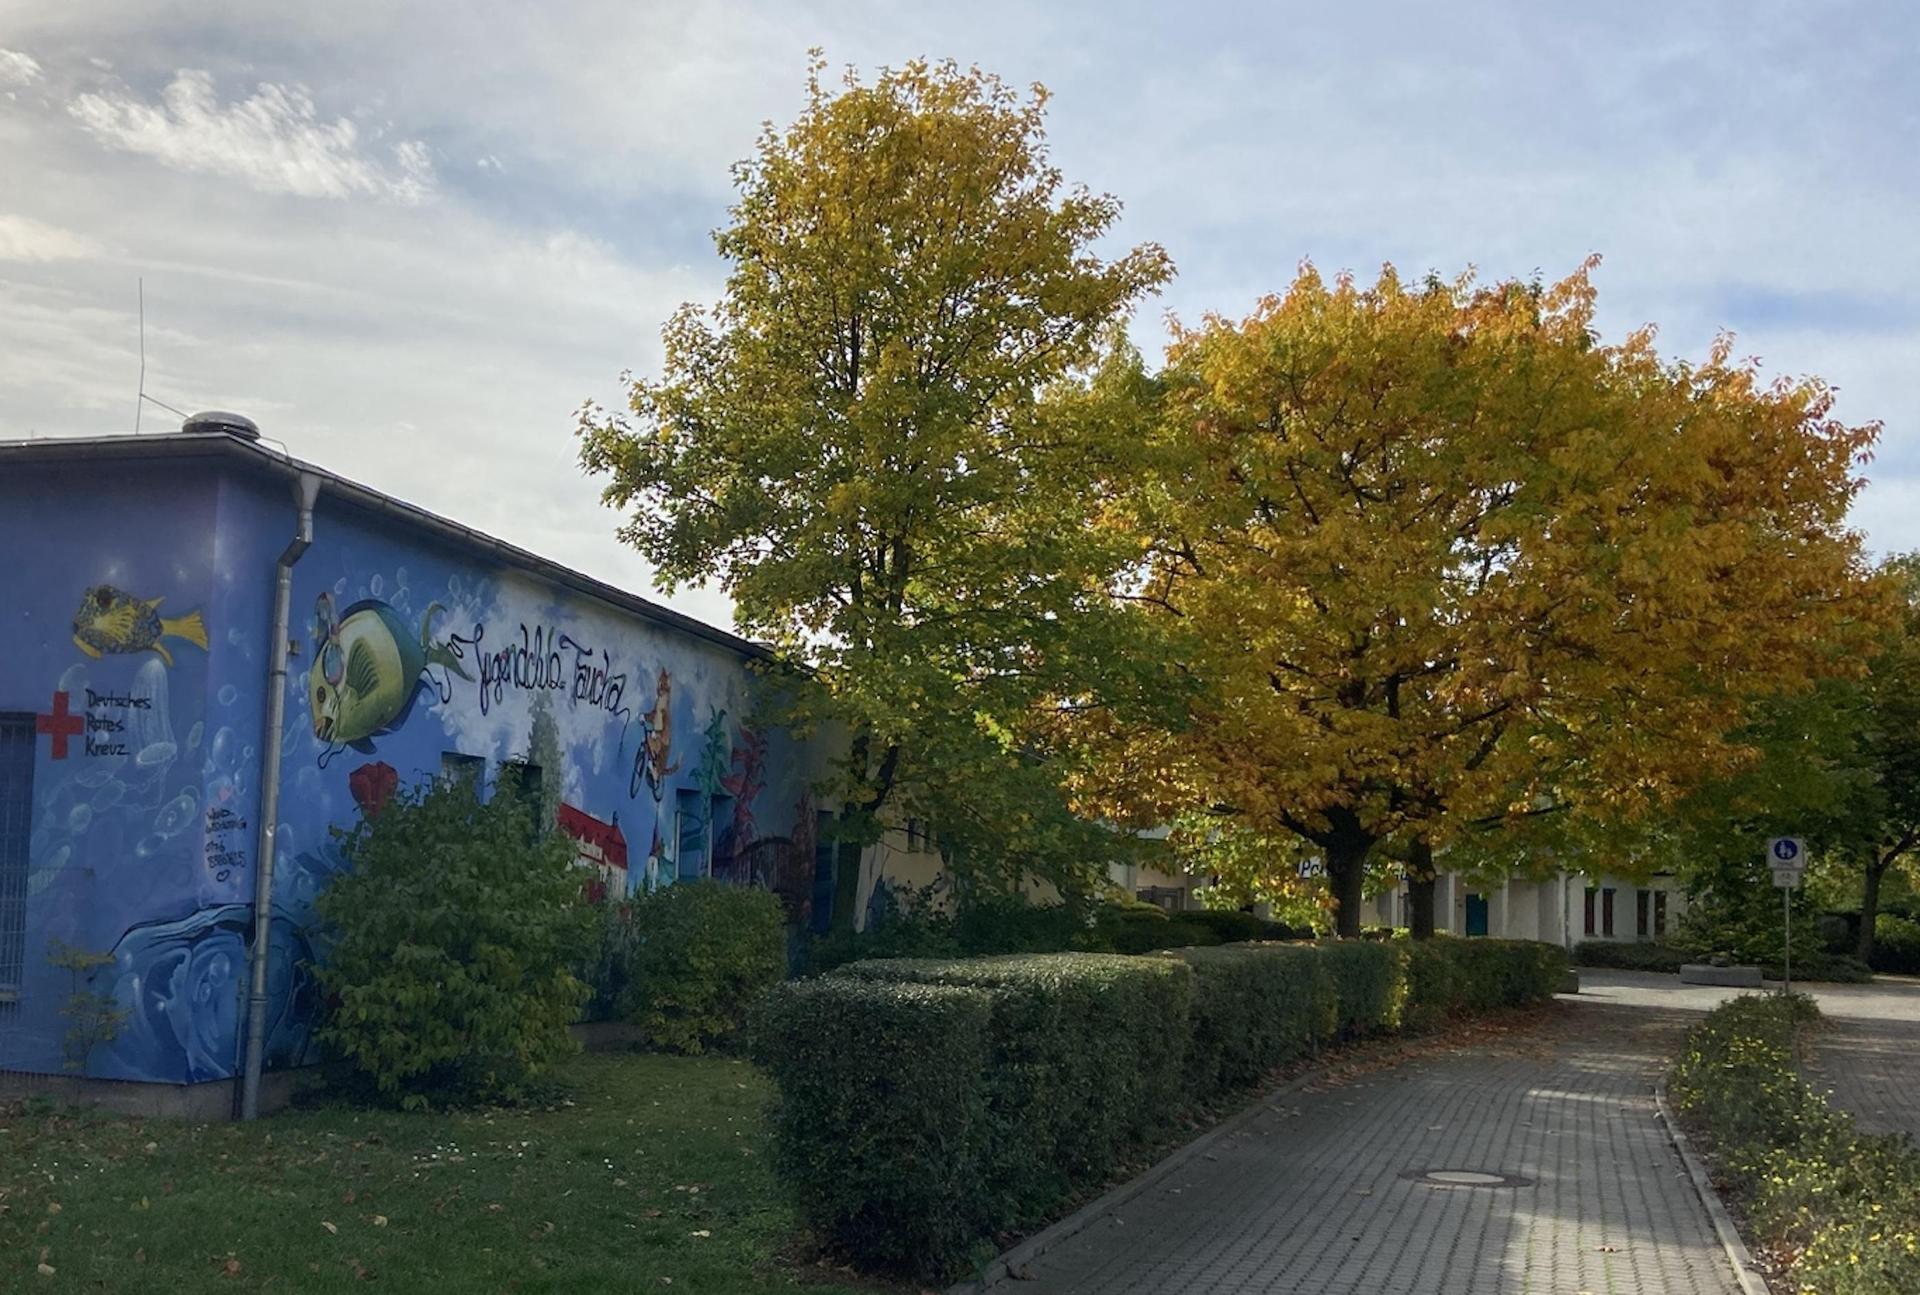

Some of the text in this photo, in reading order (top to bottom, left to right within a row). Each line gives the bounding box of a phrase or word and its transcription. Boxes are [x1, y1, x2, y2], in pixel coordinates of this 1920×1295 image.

[85, 688, 151, 710] Deutsches
[85, 711, 125, 732] Rotes
[85, 735, 130, 757] Kreuz
